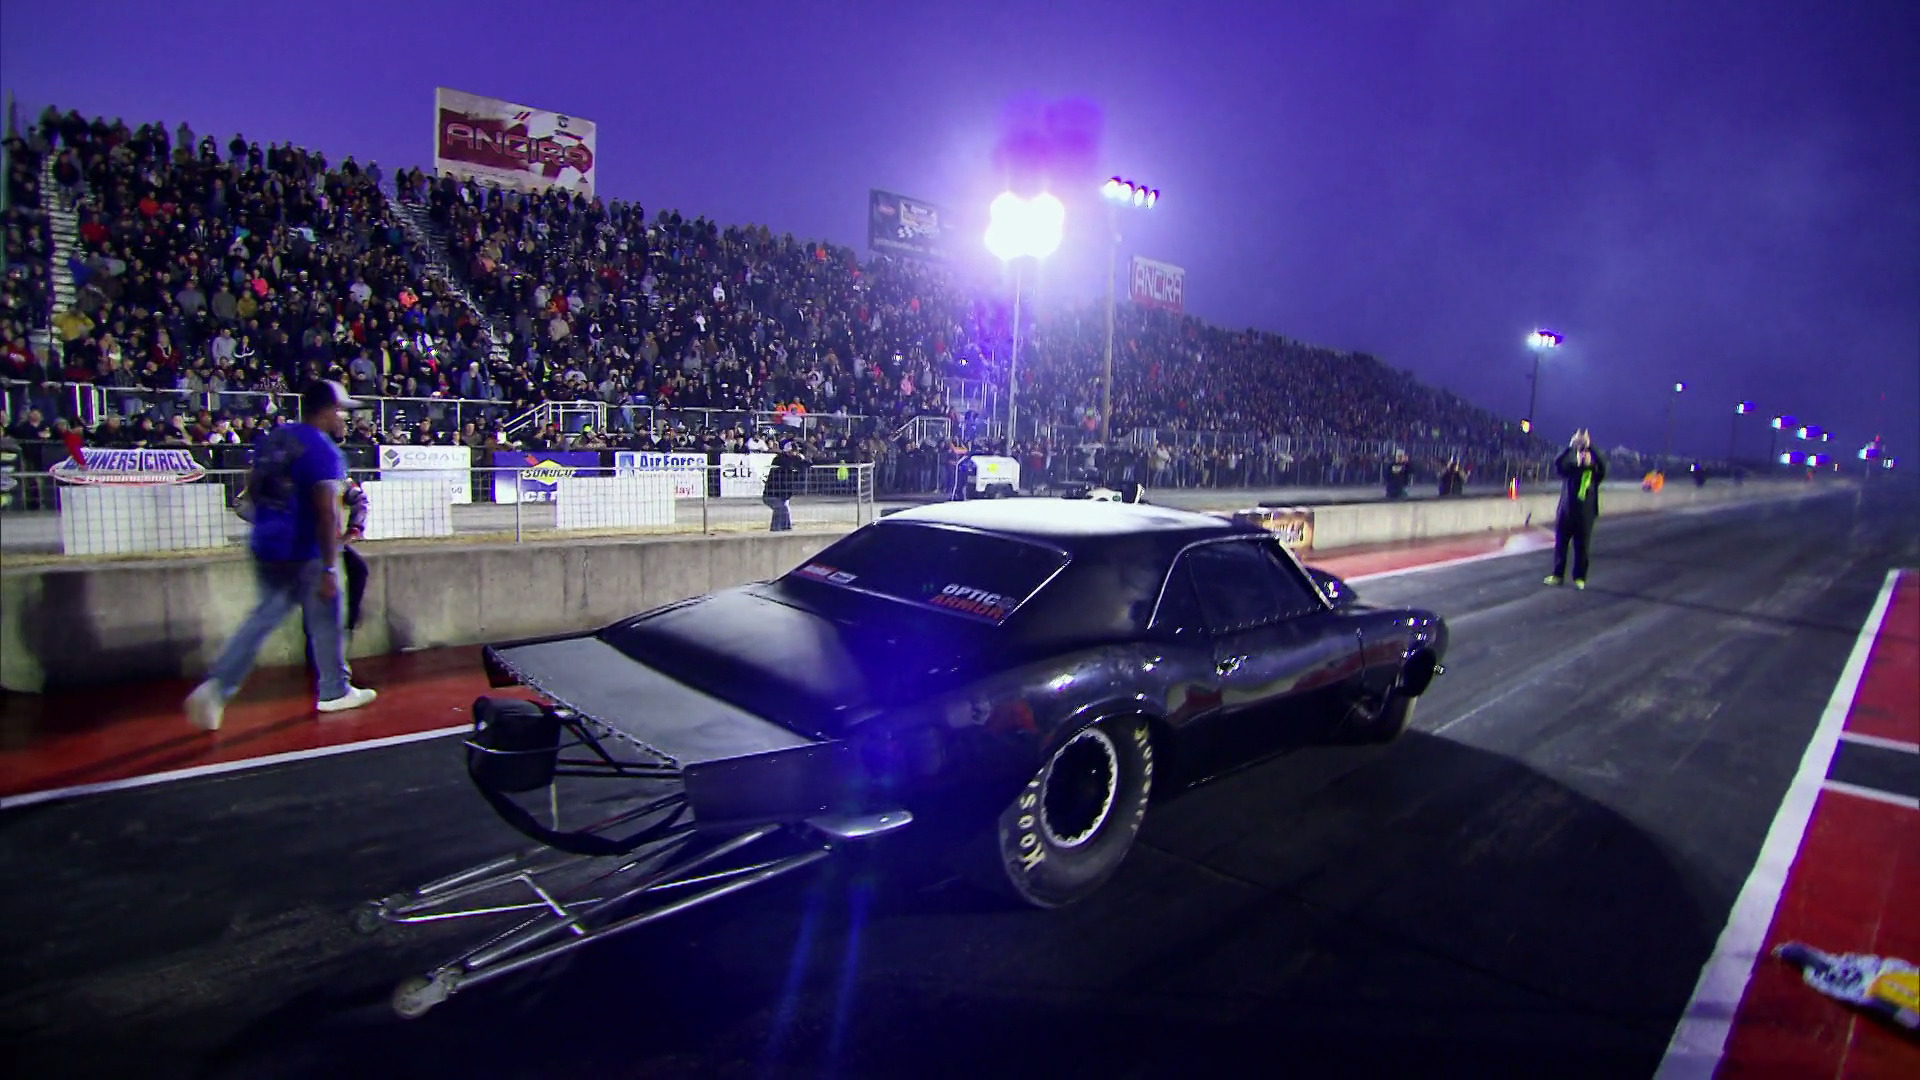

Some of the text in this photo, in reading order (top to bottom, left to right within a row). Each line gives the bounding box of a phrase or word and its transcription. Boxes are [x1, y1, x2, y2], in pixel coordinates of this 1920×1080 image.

[447, 122, 593, 171] ANCIRA
[1133, 262, 1184, 305] ANCIRA
[62, 451, 197, 471] NNERS CIRCLE
[403, 452, 467, 461] COBALT
[941, 583, 1001, 606] OPTIC
[929, 594, 1004, 620] ARMOR
